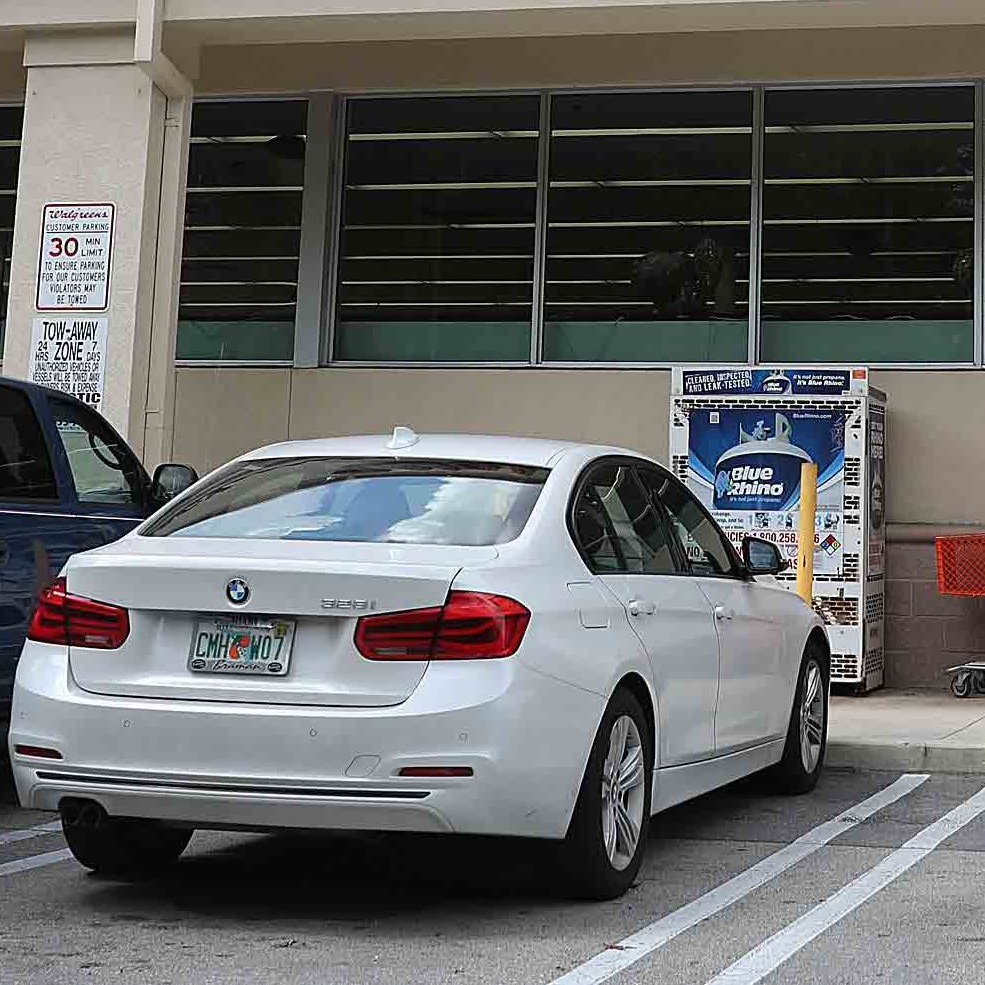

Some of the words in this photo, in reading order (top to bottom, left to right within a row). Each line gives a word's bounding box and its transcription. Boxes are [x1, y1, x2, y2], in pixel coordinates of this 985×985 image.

[49, 209, 109, 222] Walgreens
[46, 223, 80, 231] CUSTOMER
[82, 223, 109, 231] PARKING
[49, 237, 79, 257] 30
[85, 238, 101, 246] MIN
[81, 248, 103, 257] LIMIT
[45, 261, 53, 271] TO
[54, 261, 78, 271] ENSURE
[80, 261, 105, 271] PARKING
[42, 272, 54, 282] FOR
[56, 272, 69, 282] OUR
[70, 272, 106, 282] CUSTOMERS
[50, 283, 82, 293] VIOLATORS
[84, 283, 96, 293] MAY
[57, 294, 65, 304] BE
[68, 294, 88, 304] TOWED
[43, 321, 99, 341] TOW-AWAY
[37, 341, 48, 352] 24
[53, 341, 84, 361] ZONE
[92, 341, 98, 352] 7
[35, 351, 49, 362] HRS
[86, 351, 101, 362] DAYS
[35, 362, 69, 372] UNAUTHORIZED
[70, 362, 91, 372] VEHICLES
[92, 362, 100, 372] OR
[64, 372, 71, 382] BE
[72, 372, 88, 382] TOWED
[77, 382, 98, 392] EXPENSE
[688, 383, 702, 393] AND
[732, 466, 773, 481] Blue
[727, 480, 784, 496] Rhino
[196, 632, 230, 658] CMH
[250, 634, 285, 661] W07
